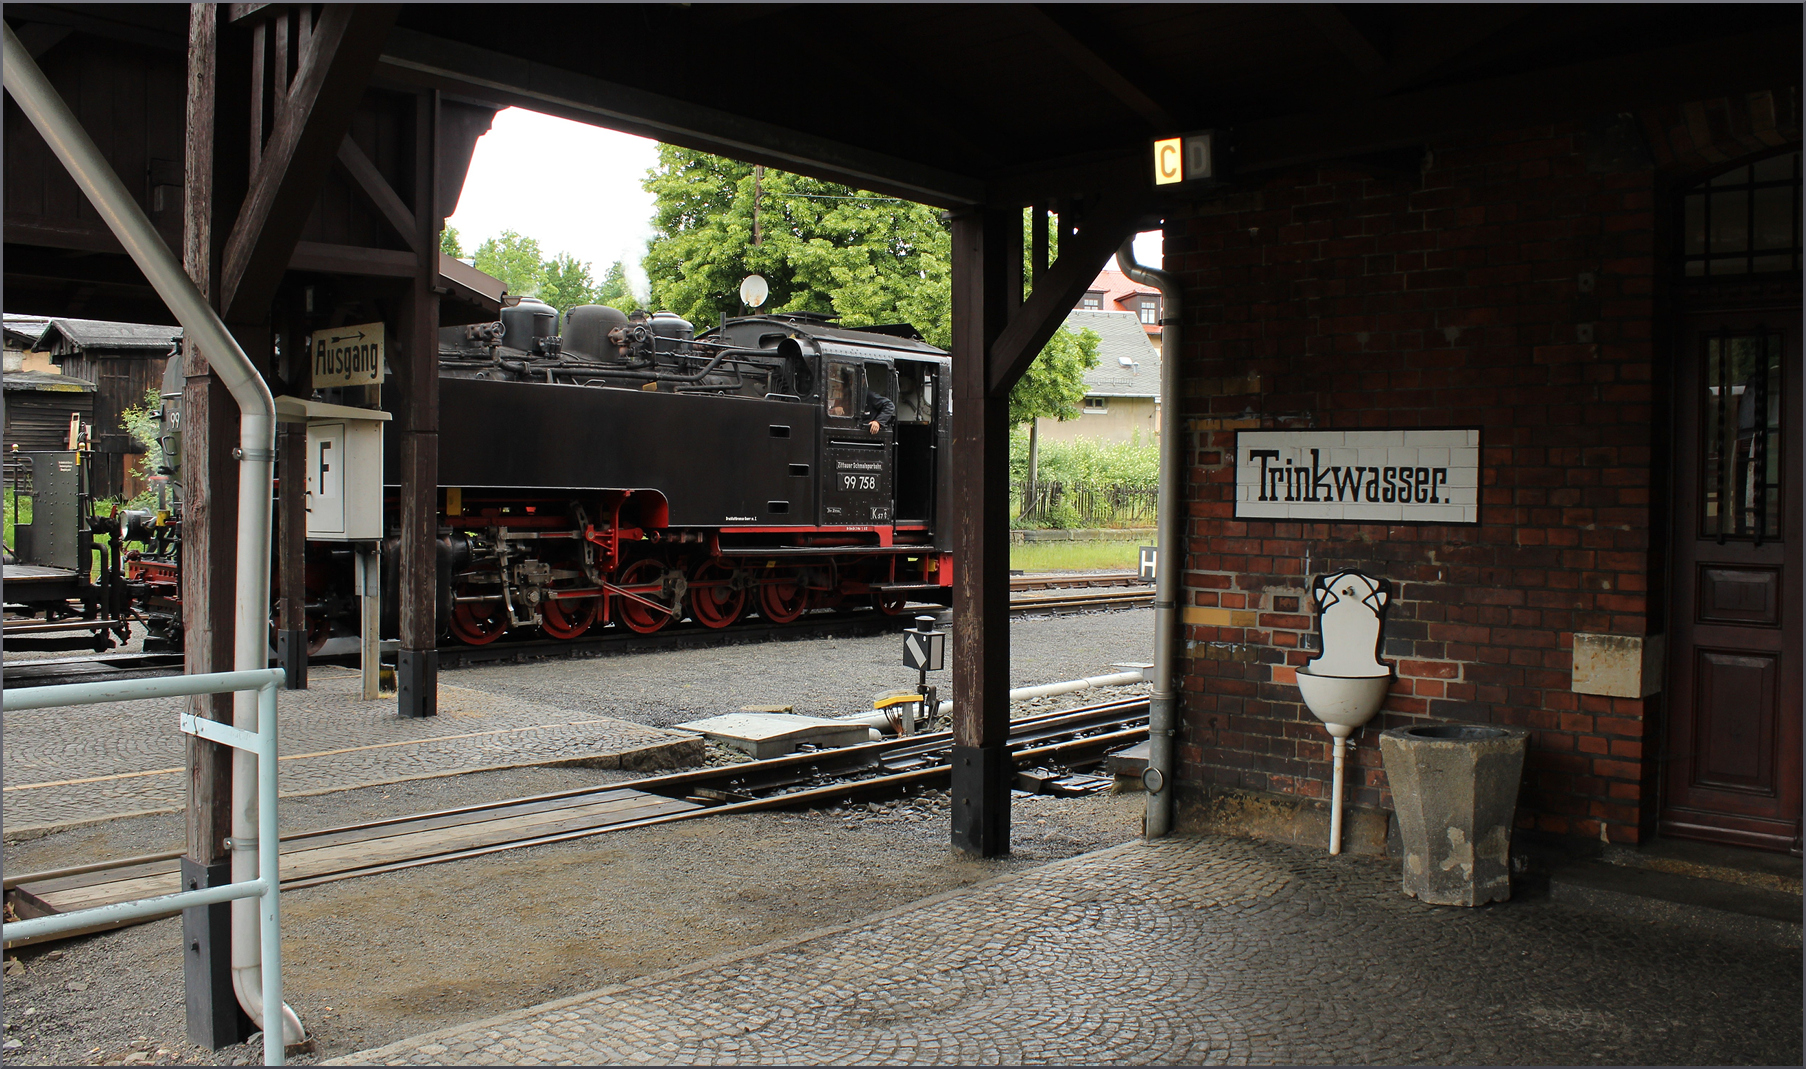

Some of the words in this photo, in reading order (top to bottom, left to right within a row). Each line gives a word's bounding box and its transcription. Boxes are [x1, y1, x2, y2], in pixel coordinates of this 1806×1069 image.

[1160, 145, 1177, 178] C
[1189, 141, 1207, 176] D
[315, 339, 378, 380] Ausgang
[170, 412, 180, 429] 99
[319, 441, 331, 495] F
[844, 475, 856, 489] 99
[859, 476, 875, 490] 758
[1249, 448, 1450, 504] Trinkwasser.
[1141, 550, 1157, 578] H
